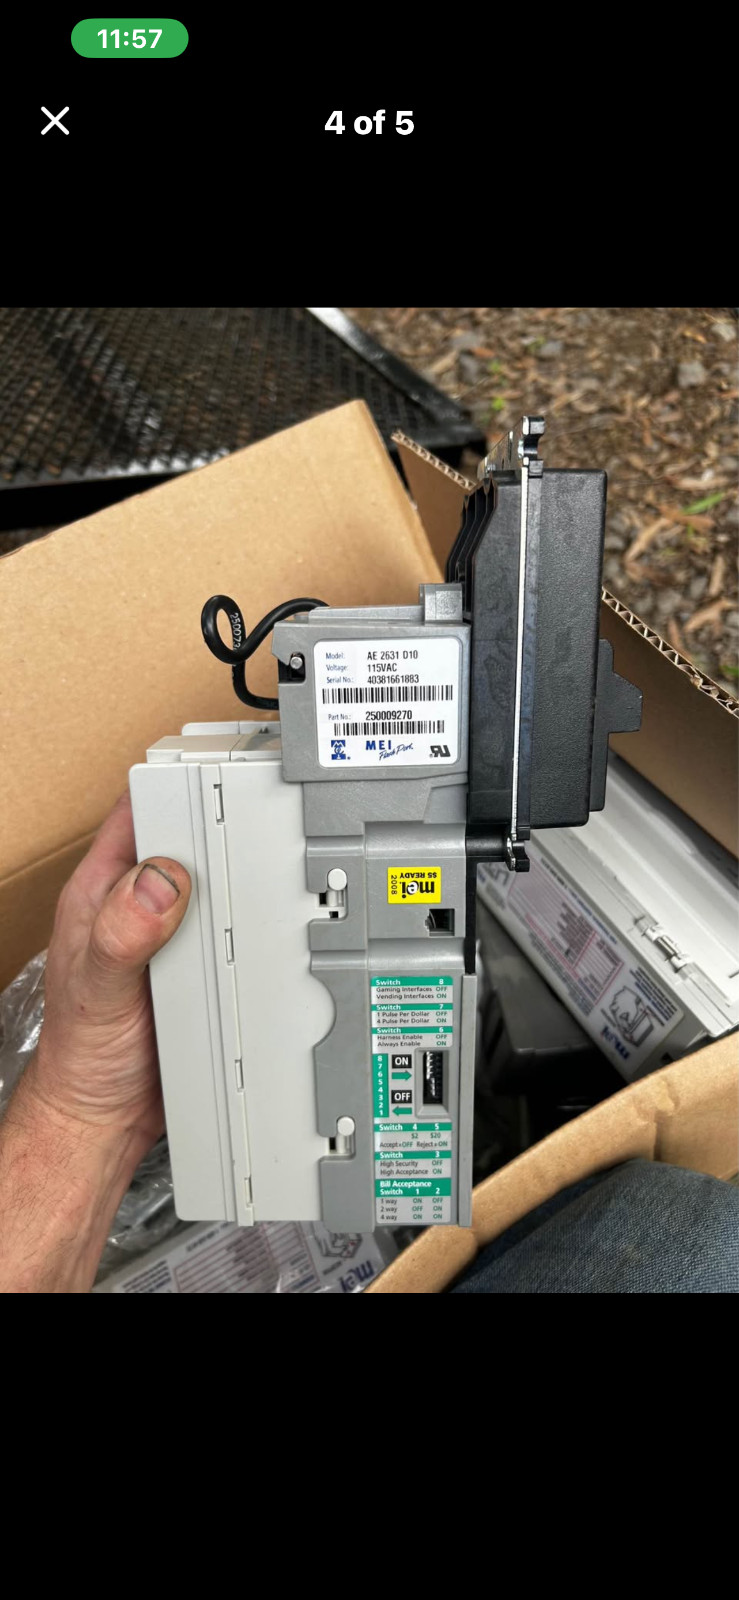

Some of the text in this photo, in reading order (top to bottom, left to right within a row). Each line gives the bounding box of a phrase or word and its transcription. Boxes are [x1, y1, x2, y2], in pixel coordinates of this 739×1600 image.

[230, 612, 242, 651] 250073
[326, 650, 418, 660] Model: AE 2631 D10
[326, 663, 397, 672] Voltage: 115VAC
[326, 676, 342, 684] Serial
[367, 674, 419, 684] 40381661883
[365, 710, 413, 721] 250009270
[365, 740, 392, 750] MEI
[401, 880, 435, 899] mei
[394, 1057, 408, 1065] ON
[394, 1092, 411, 1101] OFF
[392, 1180, 432, 1188] Acceptance
